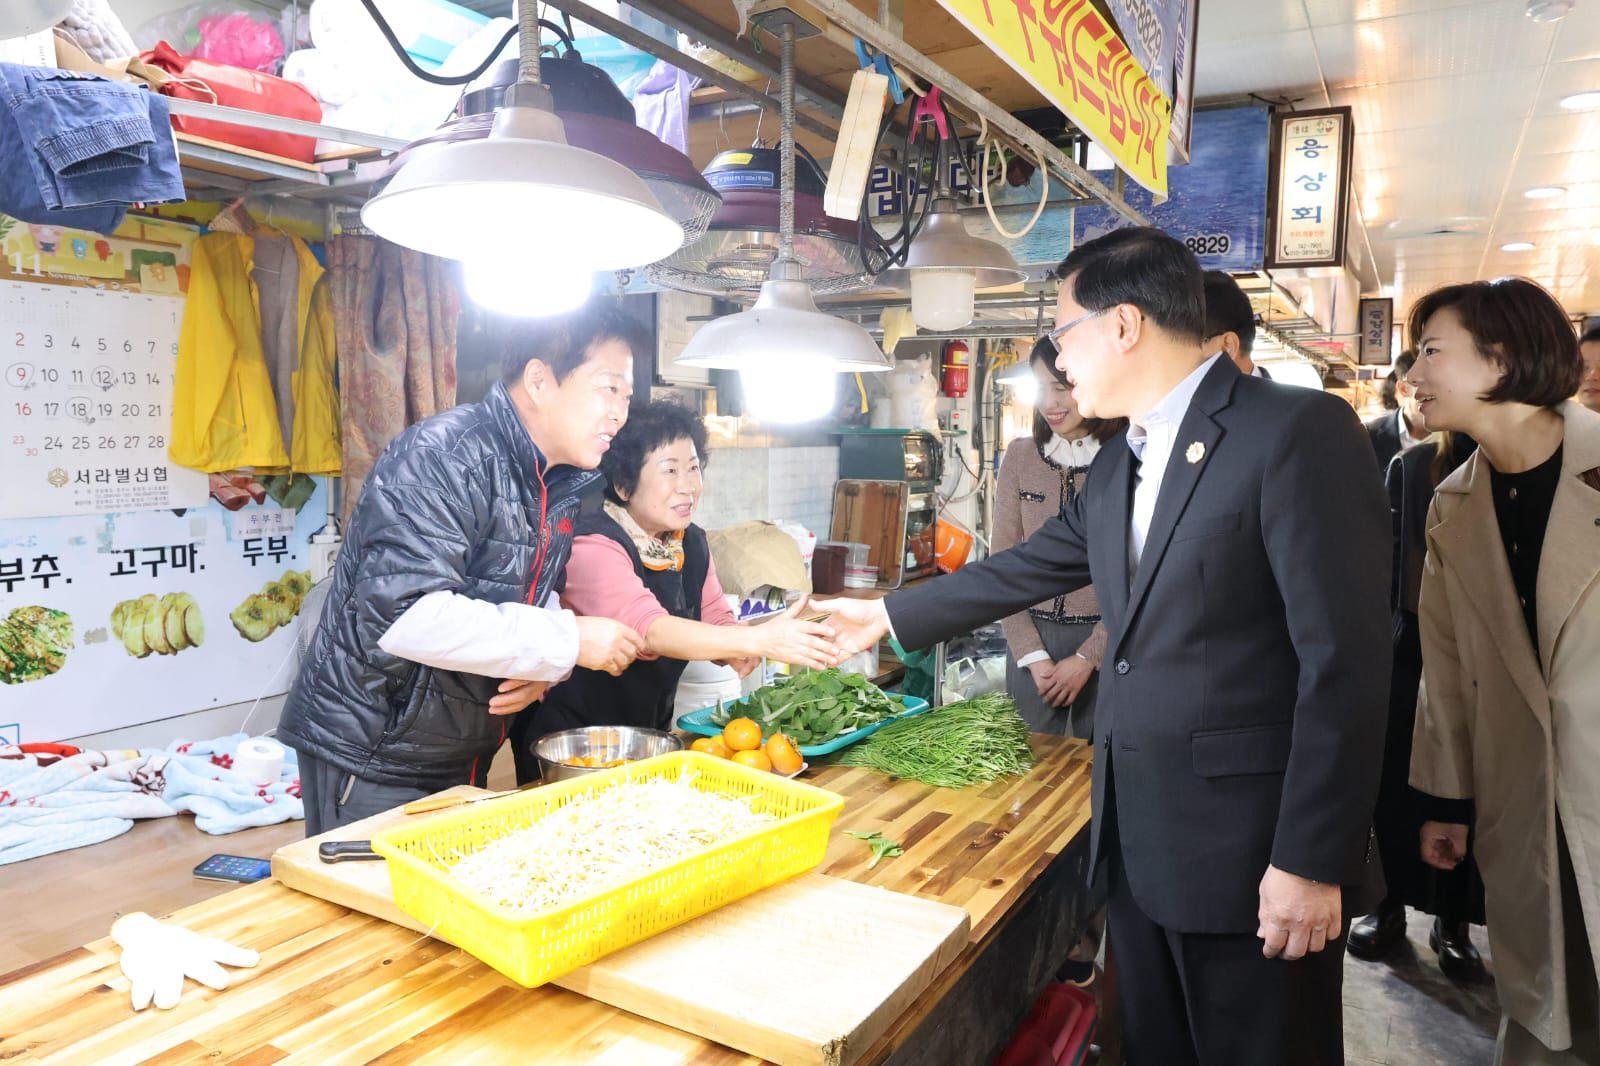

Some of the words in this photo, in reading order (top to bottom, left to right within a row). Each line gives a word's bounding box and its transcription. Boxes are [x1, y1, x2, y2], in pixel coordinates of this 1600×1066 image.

[10, 251, 45, 278] 11
[47, 270, 90, 283] November
[15, 332, 25, 347] 2
[44, 335, 54, 349] 3
[71, 336, 81, 350] 4
[97, 338, 107, 352] 5
[123, 340, 133, 353] 6
[147, 341, 156, 354] 7
[171, 342, 179, 356] 8
[16, 368, 27, 381] 9
[41, 369, 59, 383] 10
[71, 370, 84, 383] 11
[96, 371, 112, 385] 12
[121, 372, 137, 385] 13
[146, 373, 161, 386] 14
[170, 373, 176, 386] 1
[15, 403, 33, 416] 16
[43, 403, 60, 417] 17
[71, 403, 87, 417] 18
[98, 403, 113, 417] 19
[121, 404, 140, 417] 20
[148, 404, 162, 417] 21
[13, 436, 25, 445] 23
[43, 436, 64, 451] 24
[71, 436, 91, 450] 25
[98, 436, 117, 449] 26
[123, 436, 141, 449] 27
[147, 436, 165, 449] 28
[25, 447, 39, 457] 30
[110, 543, 206, 578] 고구마.
[243, 536, 297, 567] 두부.
[0, 554, 73, 593] 부추.
